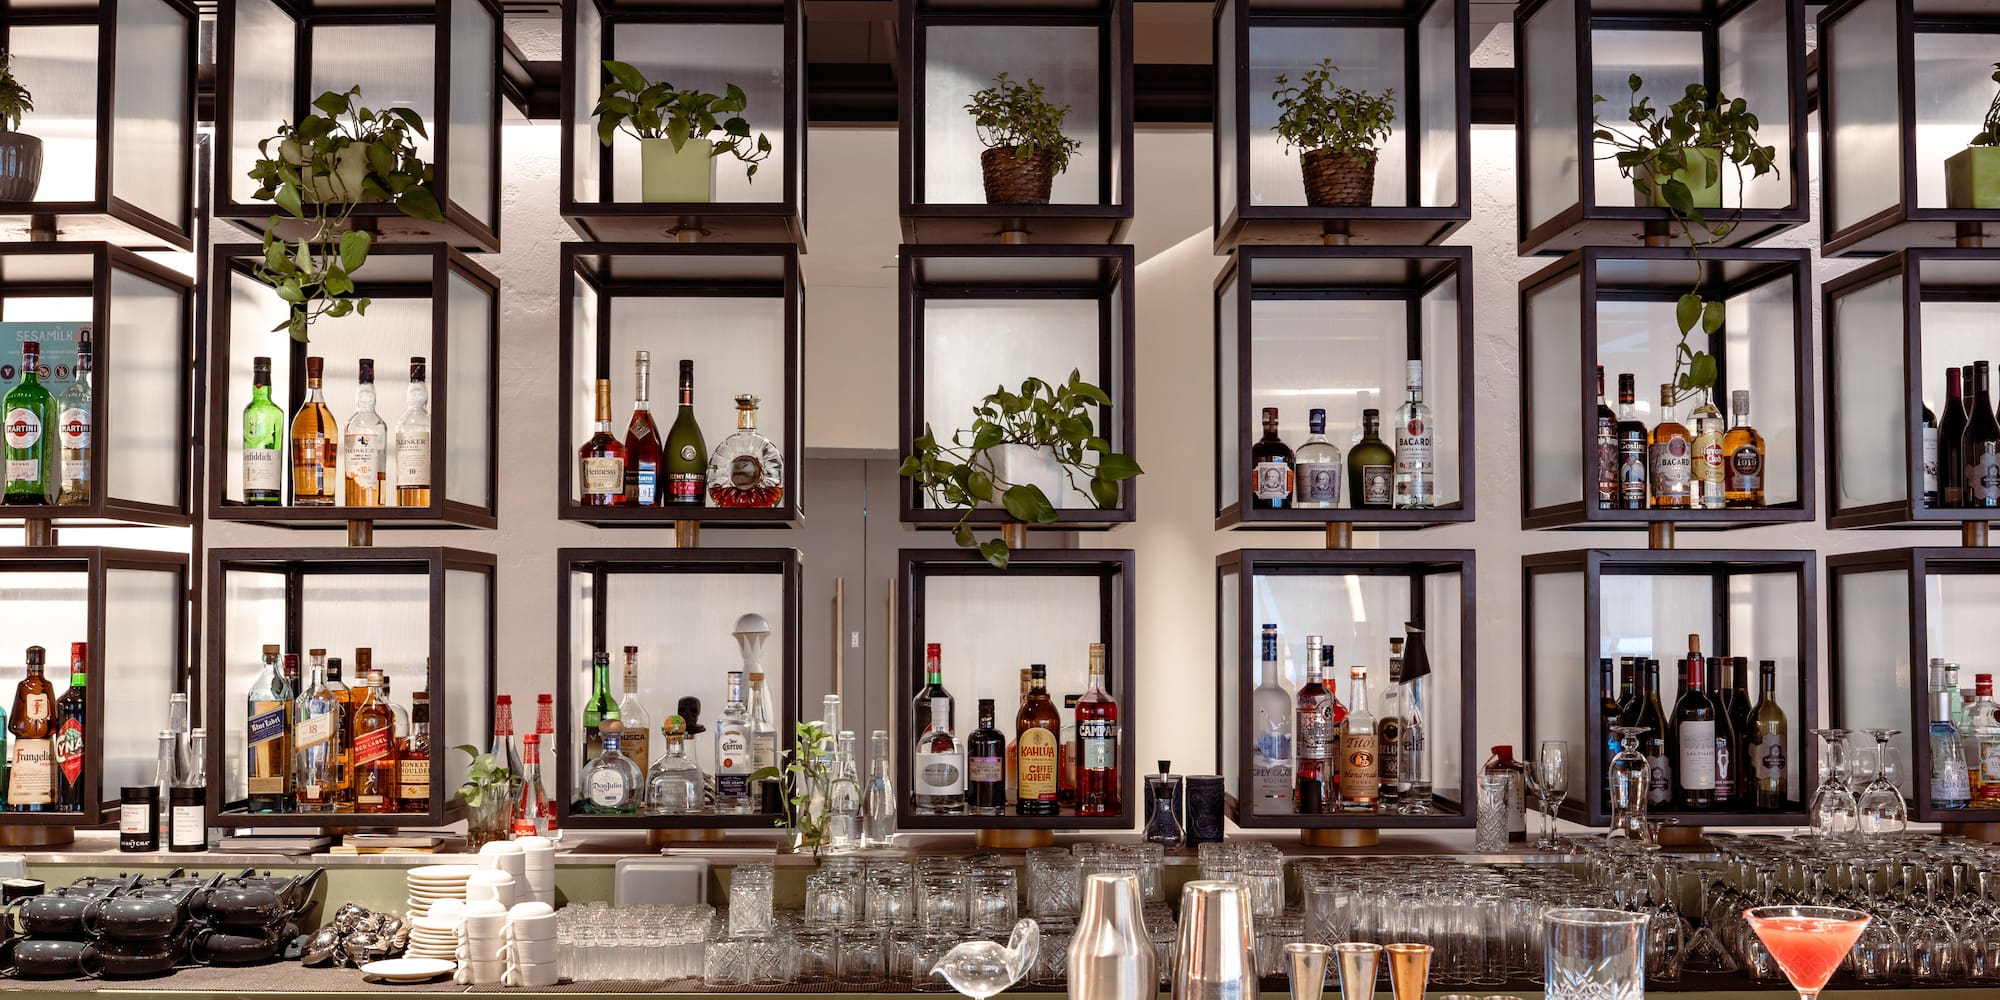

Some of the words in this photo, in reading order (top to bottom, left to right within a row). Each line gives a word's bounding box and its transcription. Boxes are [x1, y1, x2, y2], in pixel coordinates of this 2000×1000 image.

[587, 468, 616, 477] Hennessy
[251, 722, 265, 732] Blue
[265, 716, 281, 727] Label
[309, 725, 317, 733] 18
[355, 744, 367, 752] RED
[368, 738, 387, 748] LABEL
[722, 742, 743, 751] Cuervo
[1346, 738, 1376, 748] Tito's
